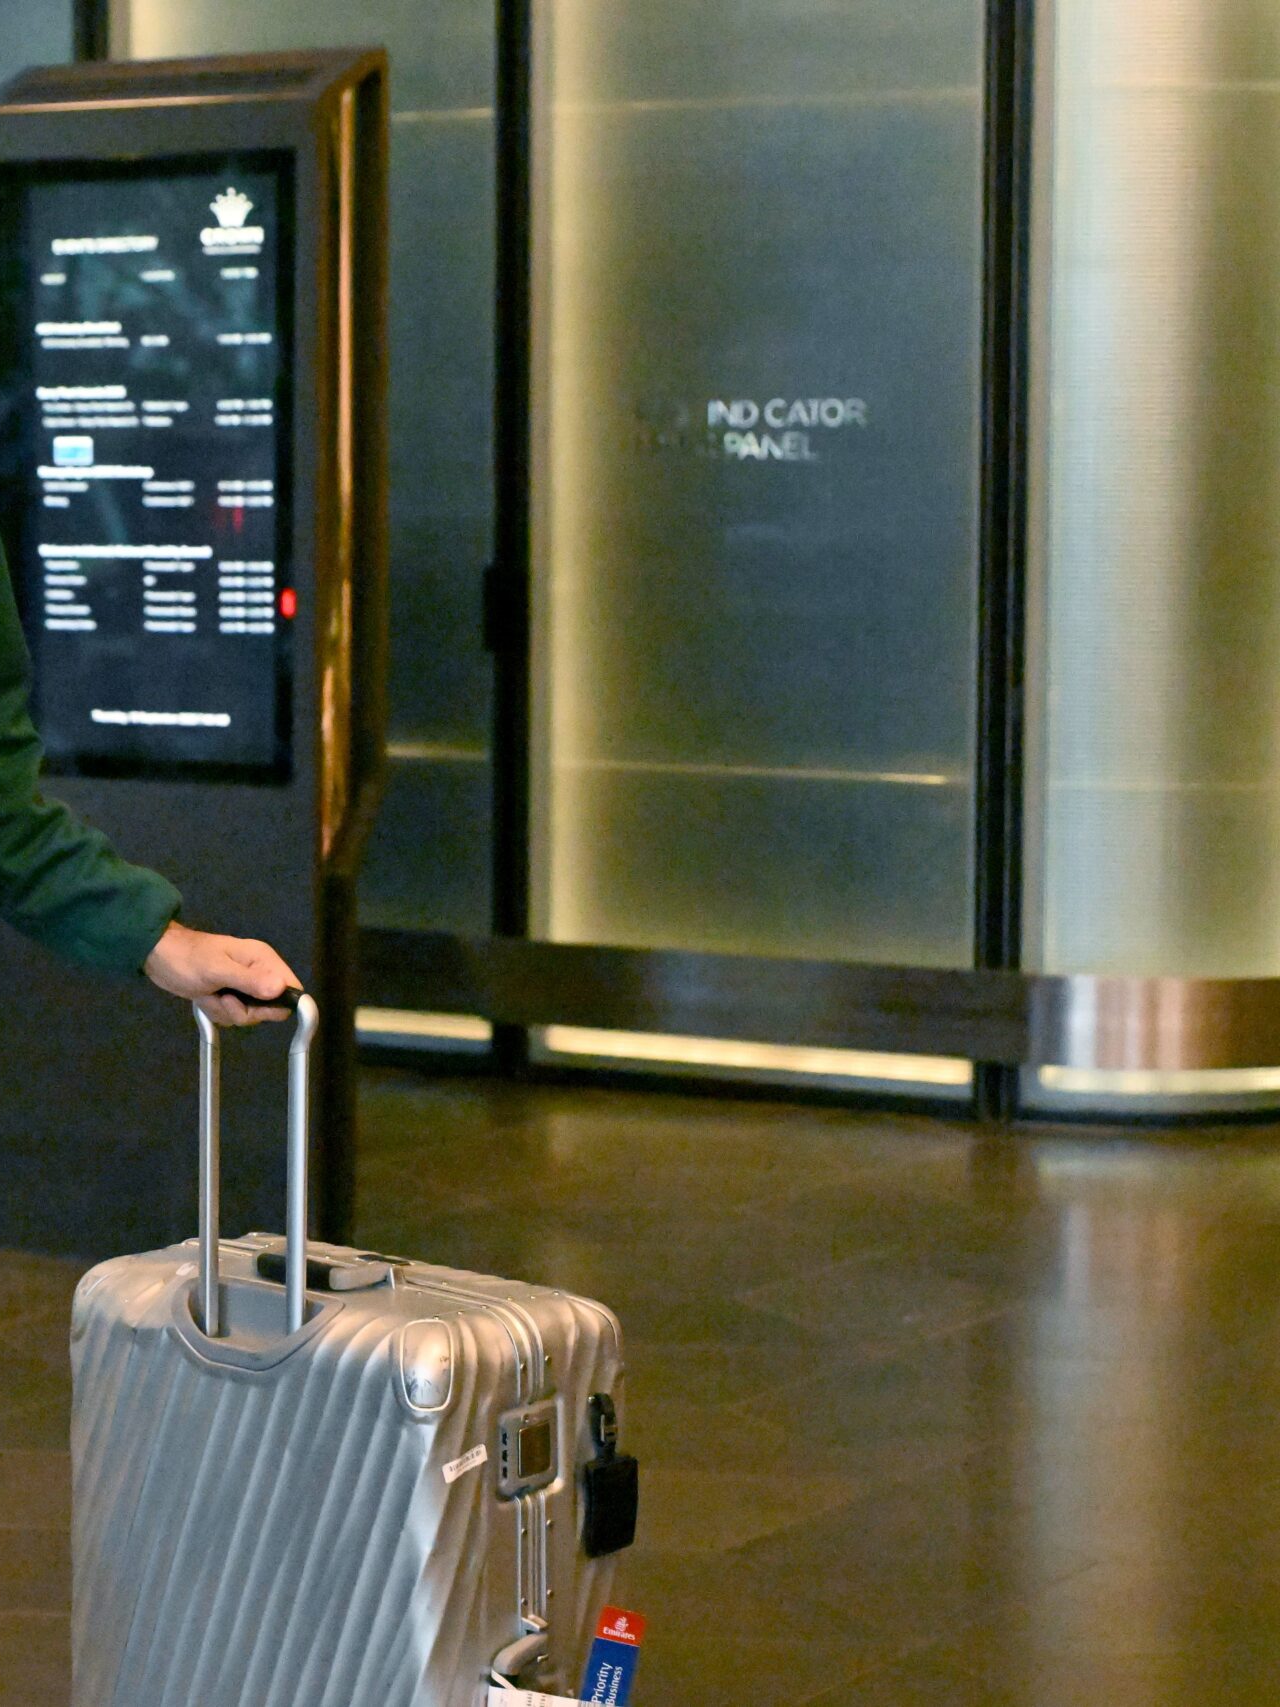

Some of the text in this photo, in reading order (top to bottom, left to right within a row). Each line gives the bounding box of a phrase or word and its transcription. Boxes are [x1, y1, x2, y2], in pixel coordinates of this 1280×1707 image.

[603, 1626, 636, 1641] Emirates
[591, 1662, 613, 1704] Priority
[605, 1665, 624, 1706] Business
